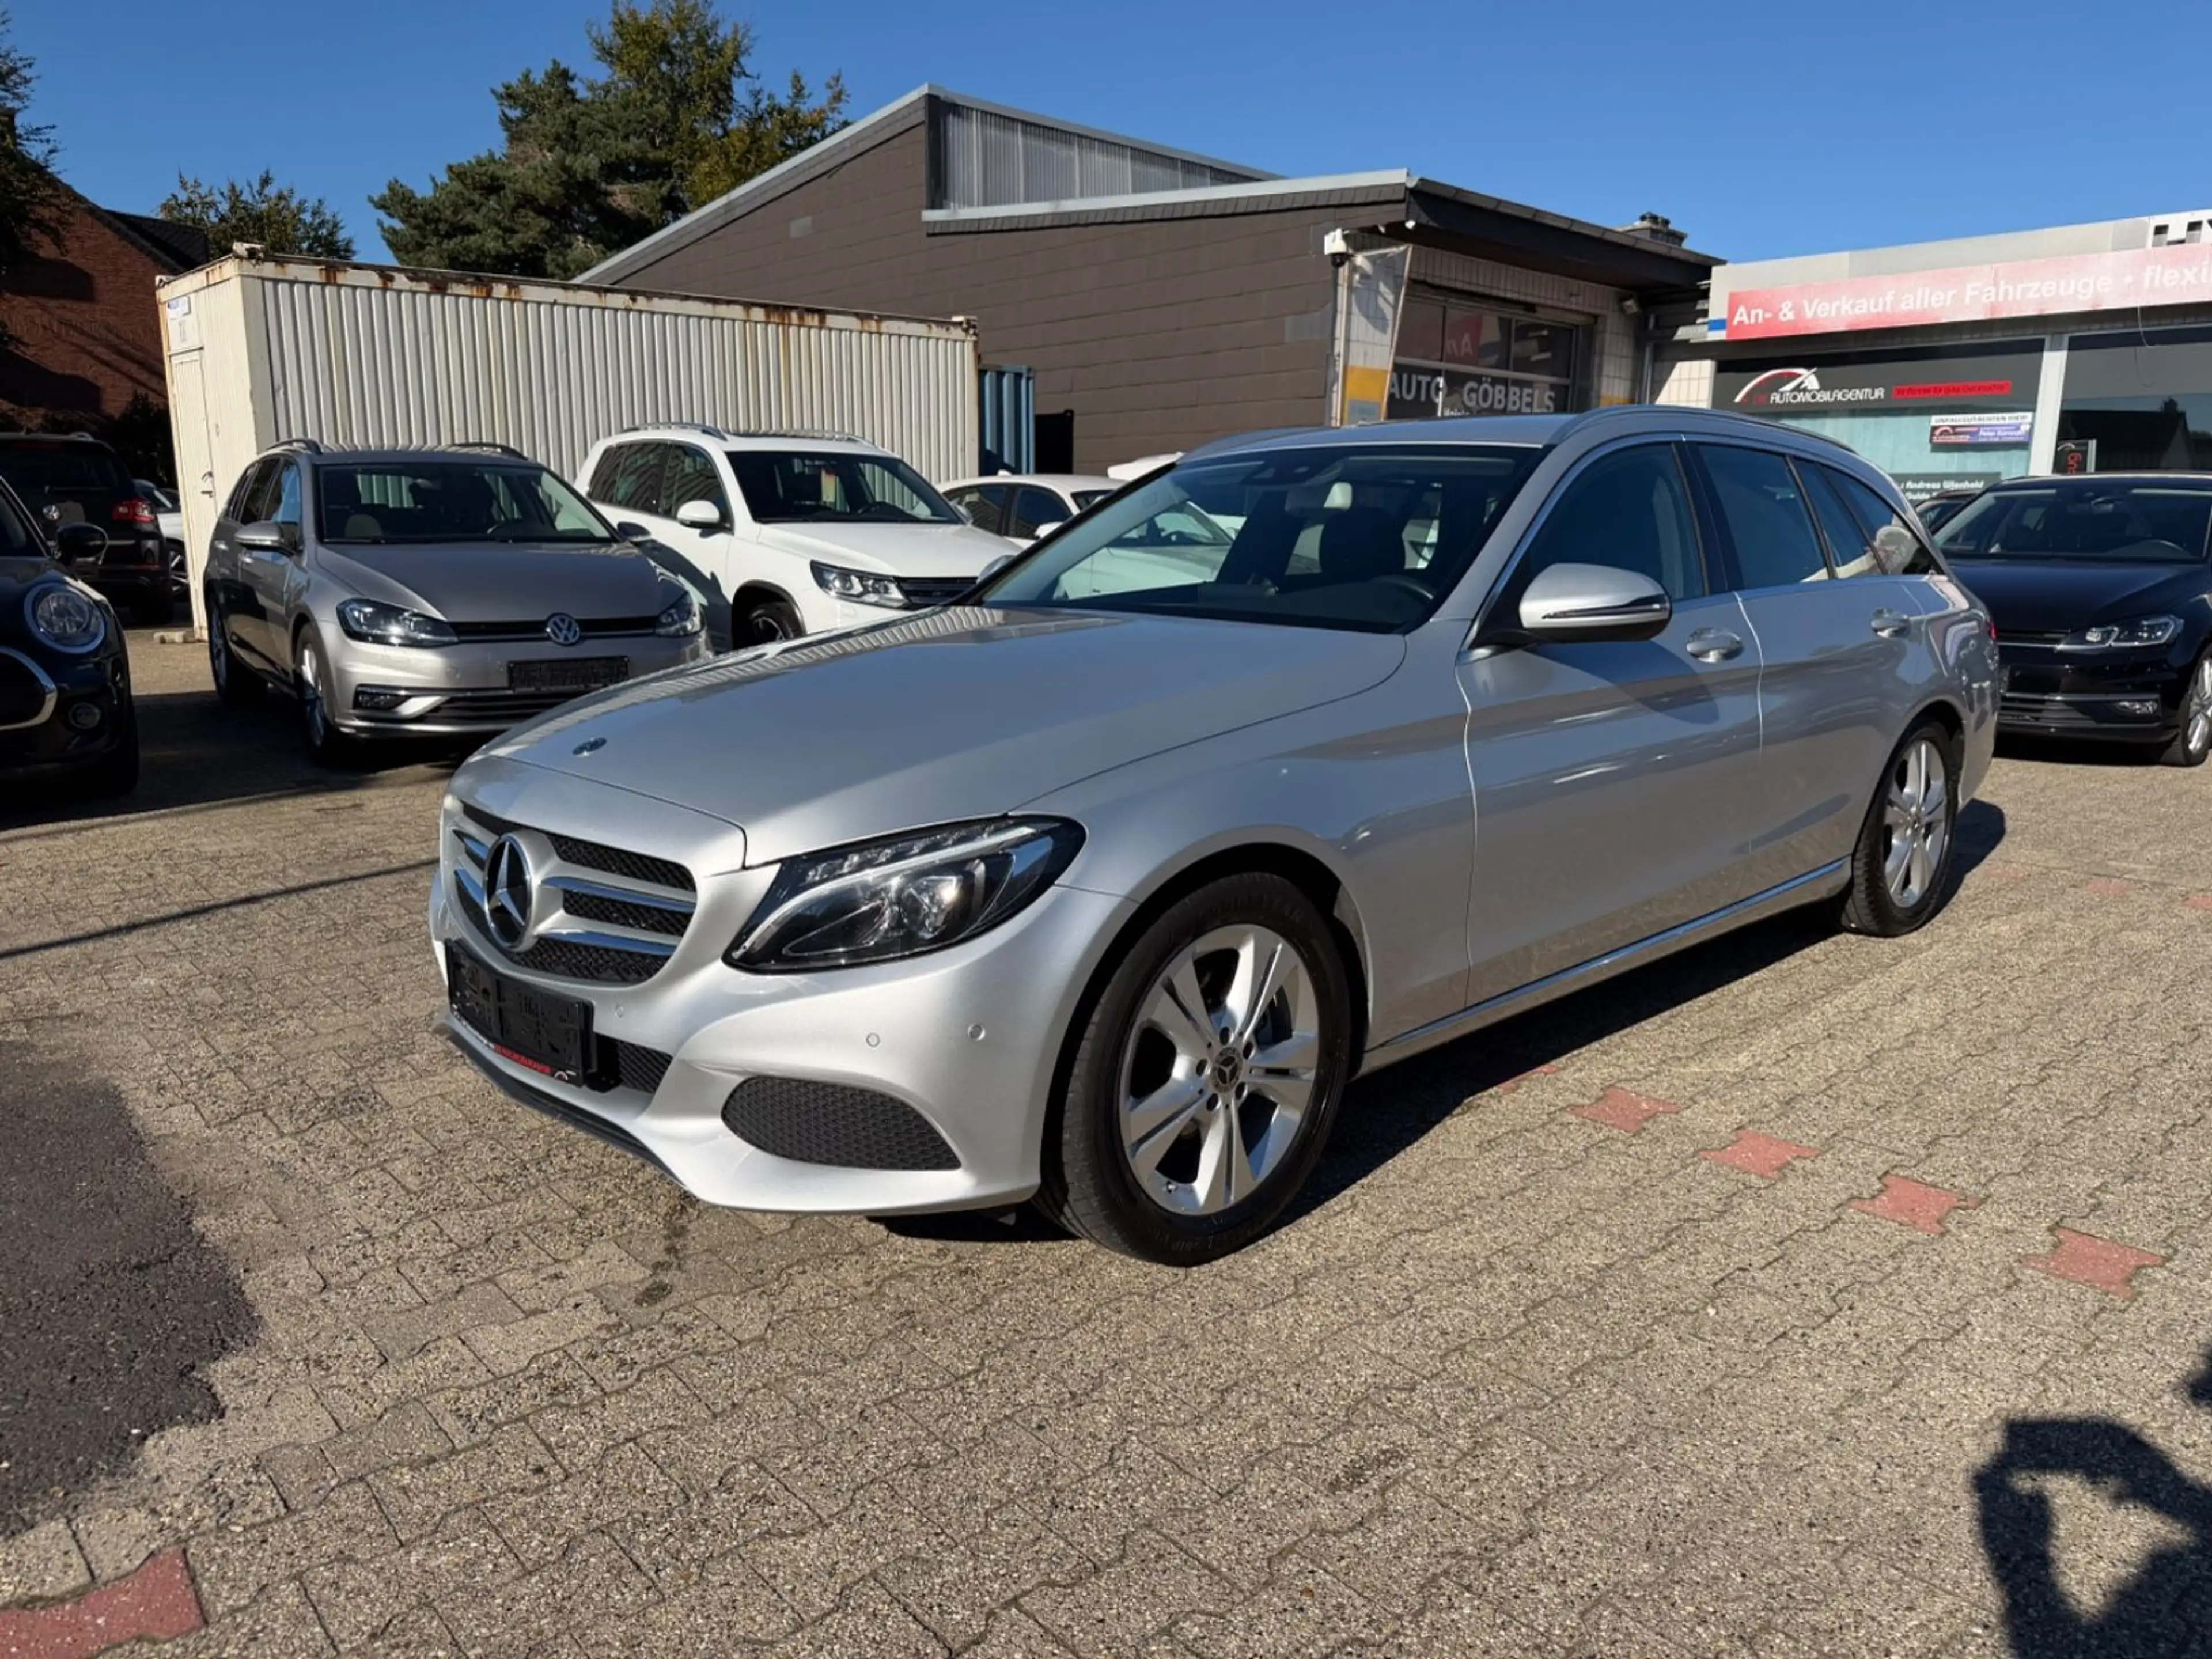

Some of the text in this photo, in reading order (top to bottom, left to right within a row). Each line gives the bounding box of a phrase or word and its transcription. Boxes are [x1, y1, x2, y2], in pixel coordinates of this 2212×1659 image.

[1732, 305, 1772, 326] An-
[1779, 300, 1795, 323] &
[1803, 290, 1895, 319] Verkauf
[1900, 287, 1957, 311] aller
[1964, 276, 2112, 305] Fahrzeuge
[1389, 372, 1555, 412] AUTO GÖBBELS
[1770, 387, 1884, 404] AUTOMOBILAGENTUR
